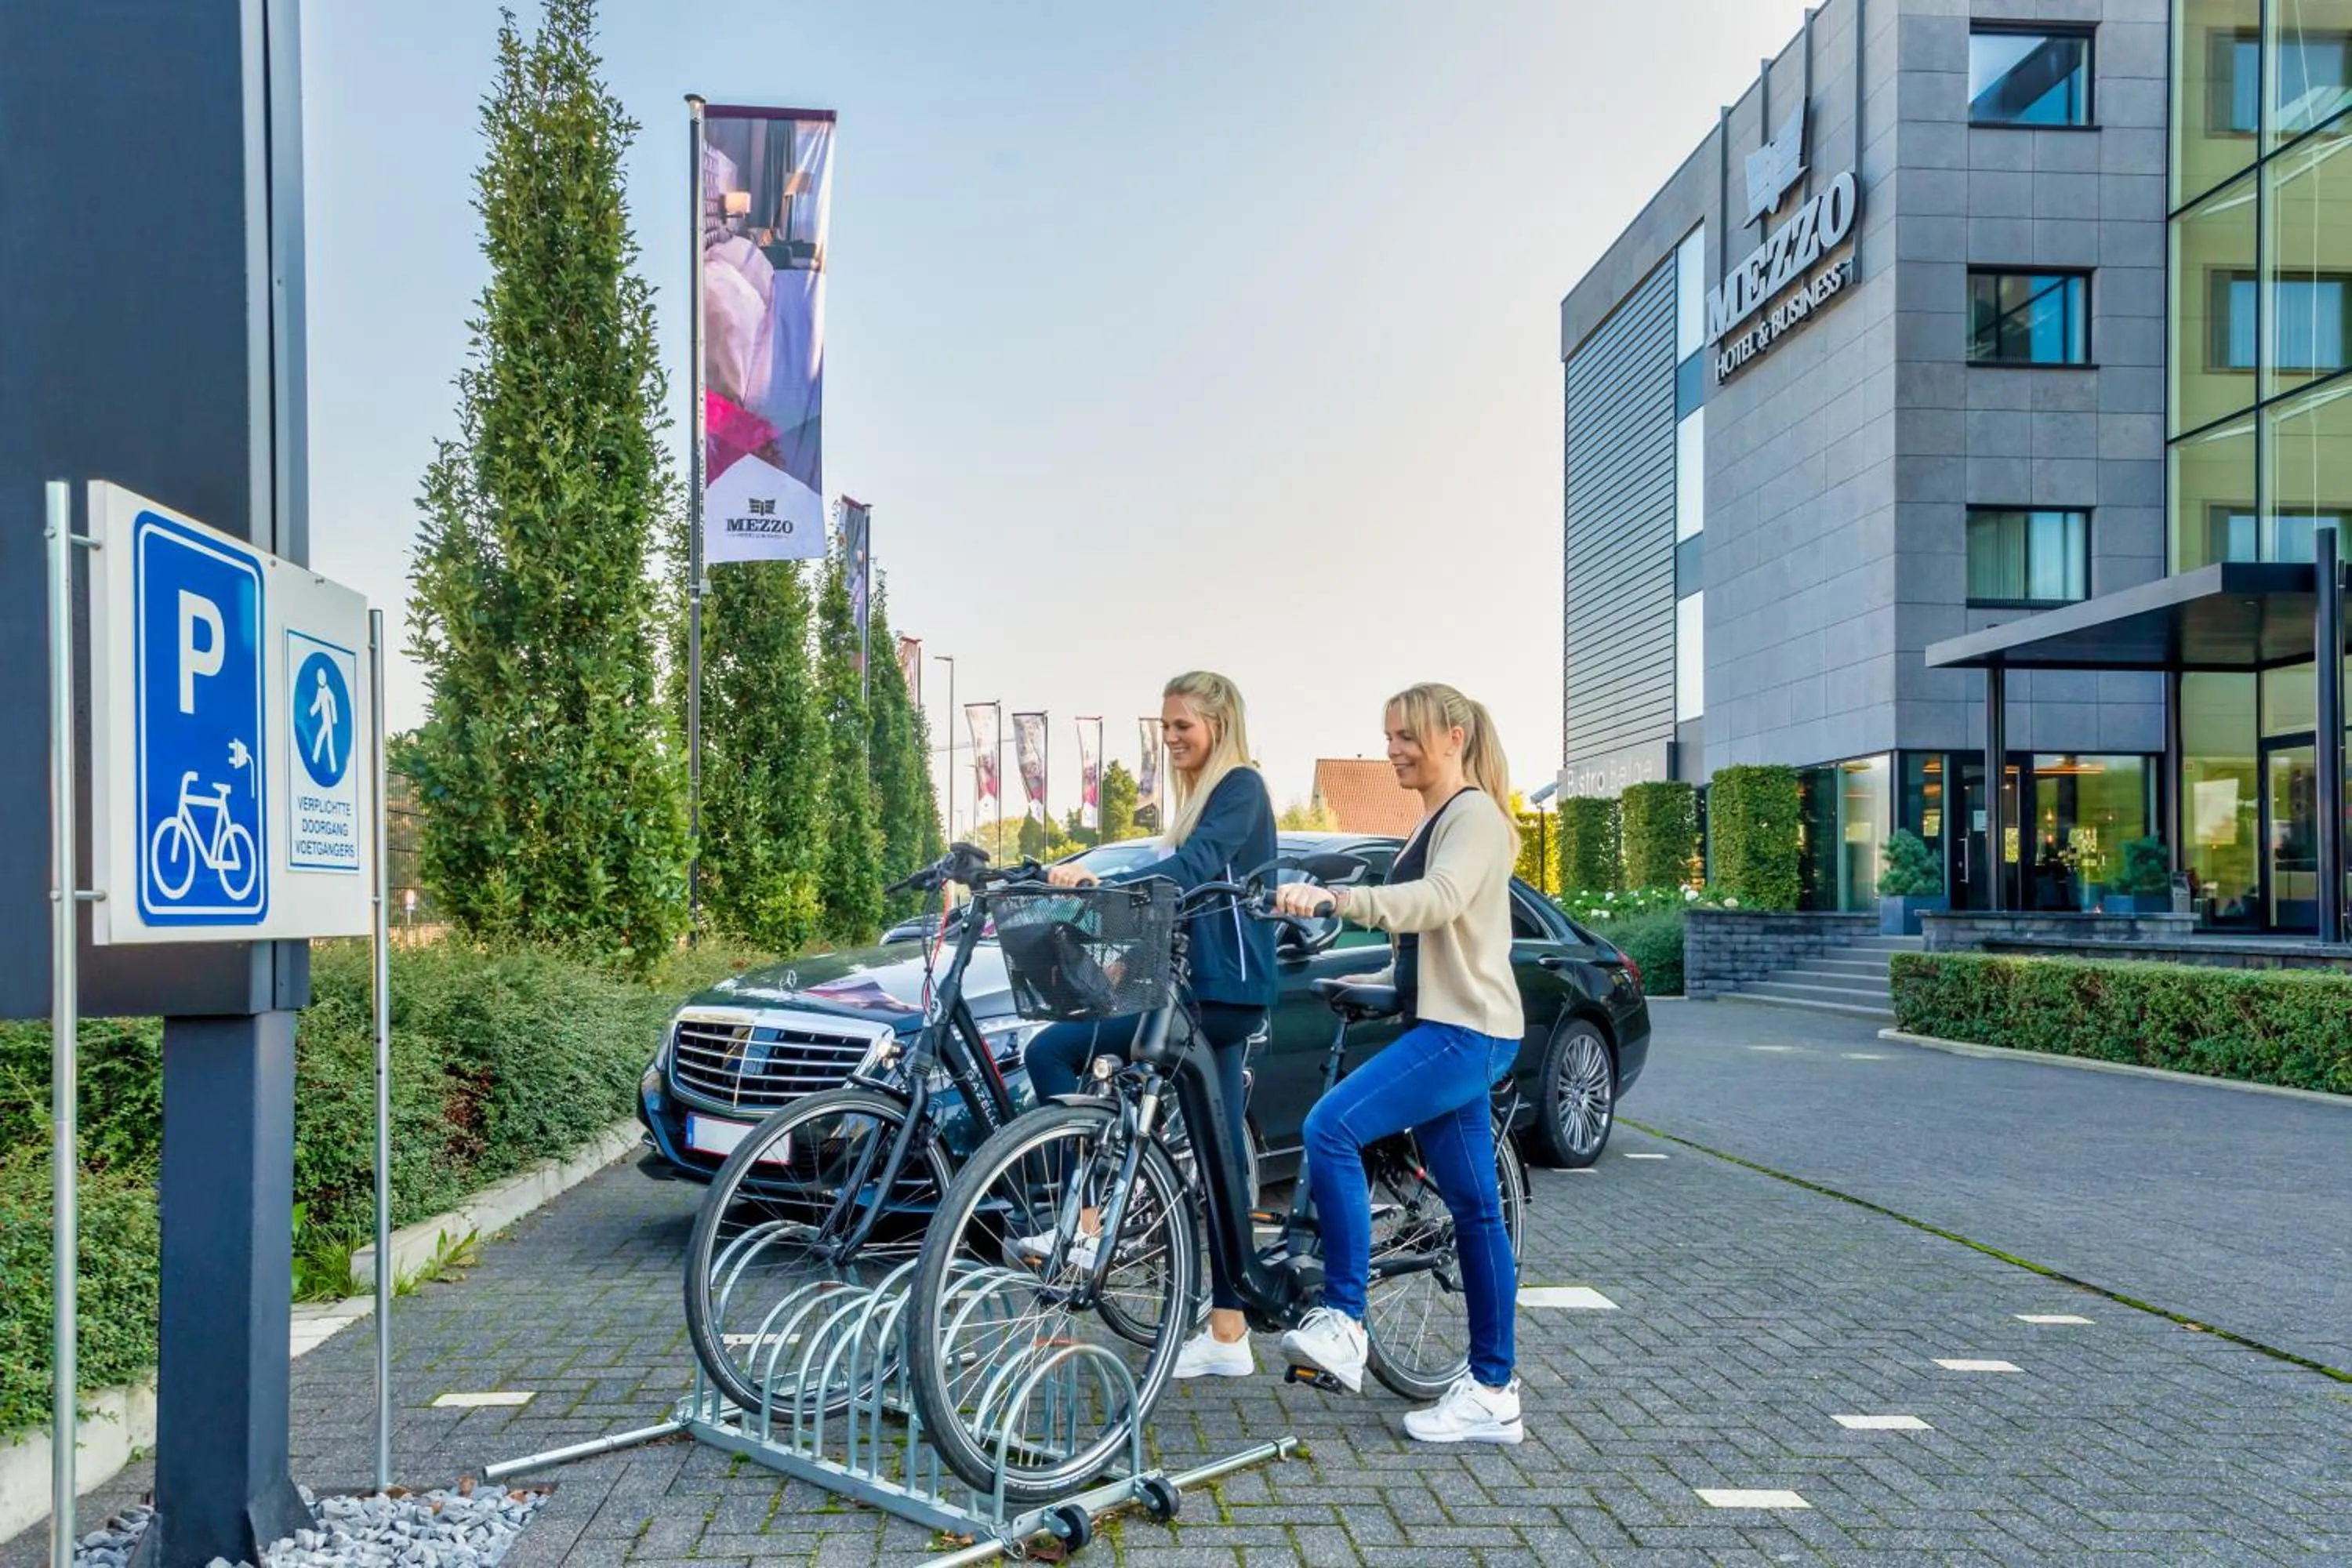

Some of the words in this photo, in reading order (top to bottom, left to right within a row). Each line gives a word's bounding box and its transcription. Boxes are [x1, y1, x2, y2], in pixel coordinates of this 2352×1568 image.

[1706, 172, 1857, 347] MEZZO
[1715, 337, 1755, 385] HOTEL
[1756, 321, 1770, 350] &
[1770, 262, 1842, 339] BUSINESS
[727, 518, 793, 534] MEZZO
[179, 590, 225, 714] P
[1568, 768, 1605, 797] Bstro
[302, 818, 349, 837] DOORGANG
[295, 840, 355, 858] VOETGANGERS
